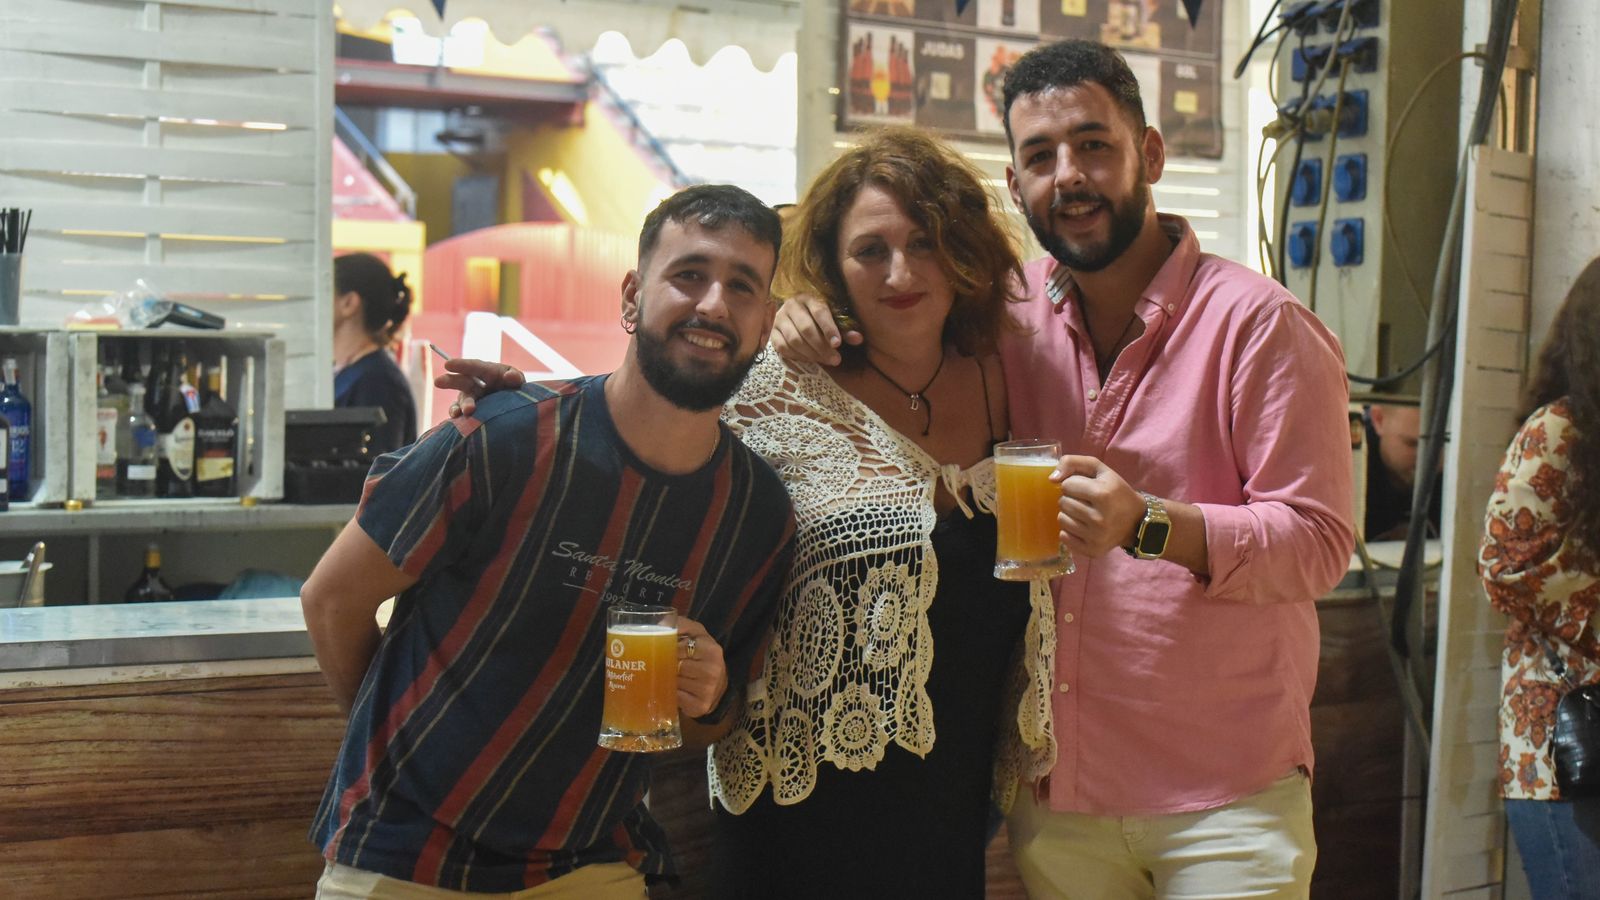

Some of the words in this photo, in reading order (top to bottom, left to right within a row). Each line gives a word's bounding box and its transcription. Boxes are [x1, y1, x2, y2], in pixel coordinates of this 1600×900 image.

[920, 40, 965, 61] JUDAS
[552, 541, 617, 570] Santa
[624, 560, 691, 590] Monica
[606, 657, 646, 671] ULANER
